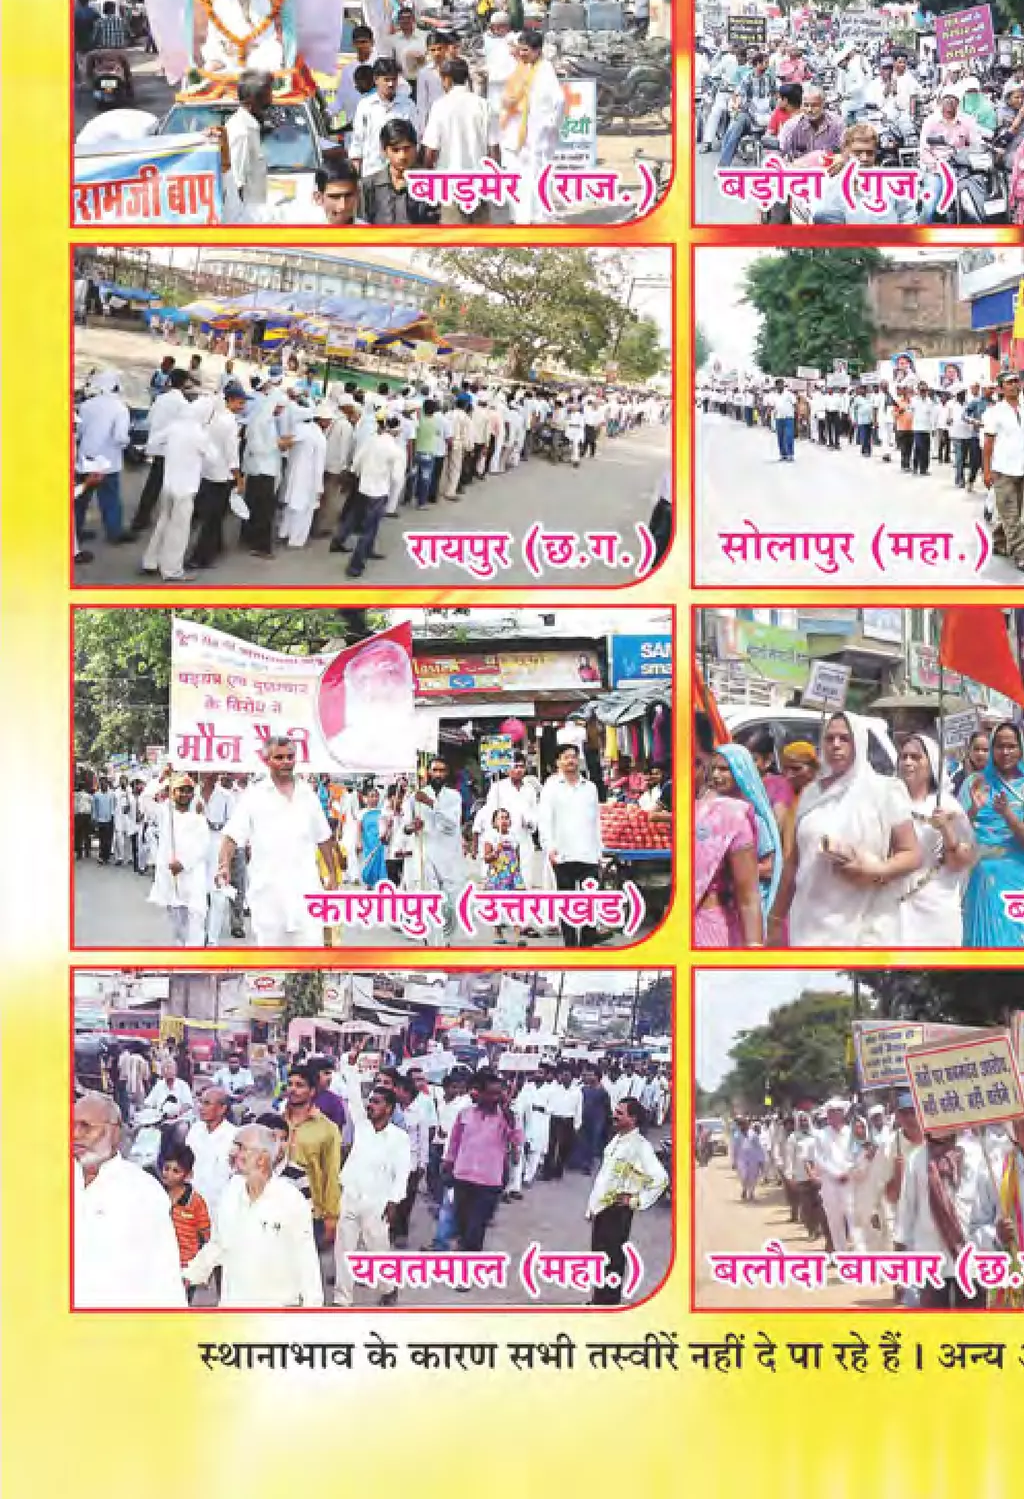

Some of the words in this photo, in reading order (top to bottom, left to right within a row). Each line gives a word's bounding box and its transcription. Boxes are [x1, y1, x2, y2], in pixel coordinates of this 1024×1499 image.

[176, 722, 243, 763] मौन
[198, 1344, 354, 1370] स्थानाभाव
[365, 1332, 397, 1370] के
[408, 1344, 497, 1370] कारण
[507, 1334, 575, 1370] सभी
[586, 1332, 678, 1370] तस्वीरें
[689, 1334, 744, 1372] नहीं
[755, 1332, 776, 1370] दे
[787, 1344, 823, 1369] पा
[833, 1332, 868, 1372] रहे
[879, 1332, 901, 1370] हैं
[939, 1344, 1005, 1370] अन्य
